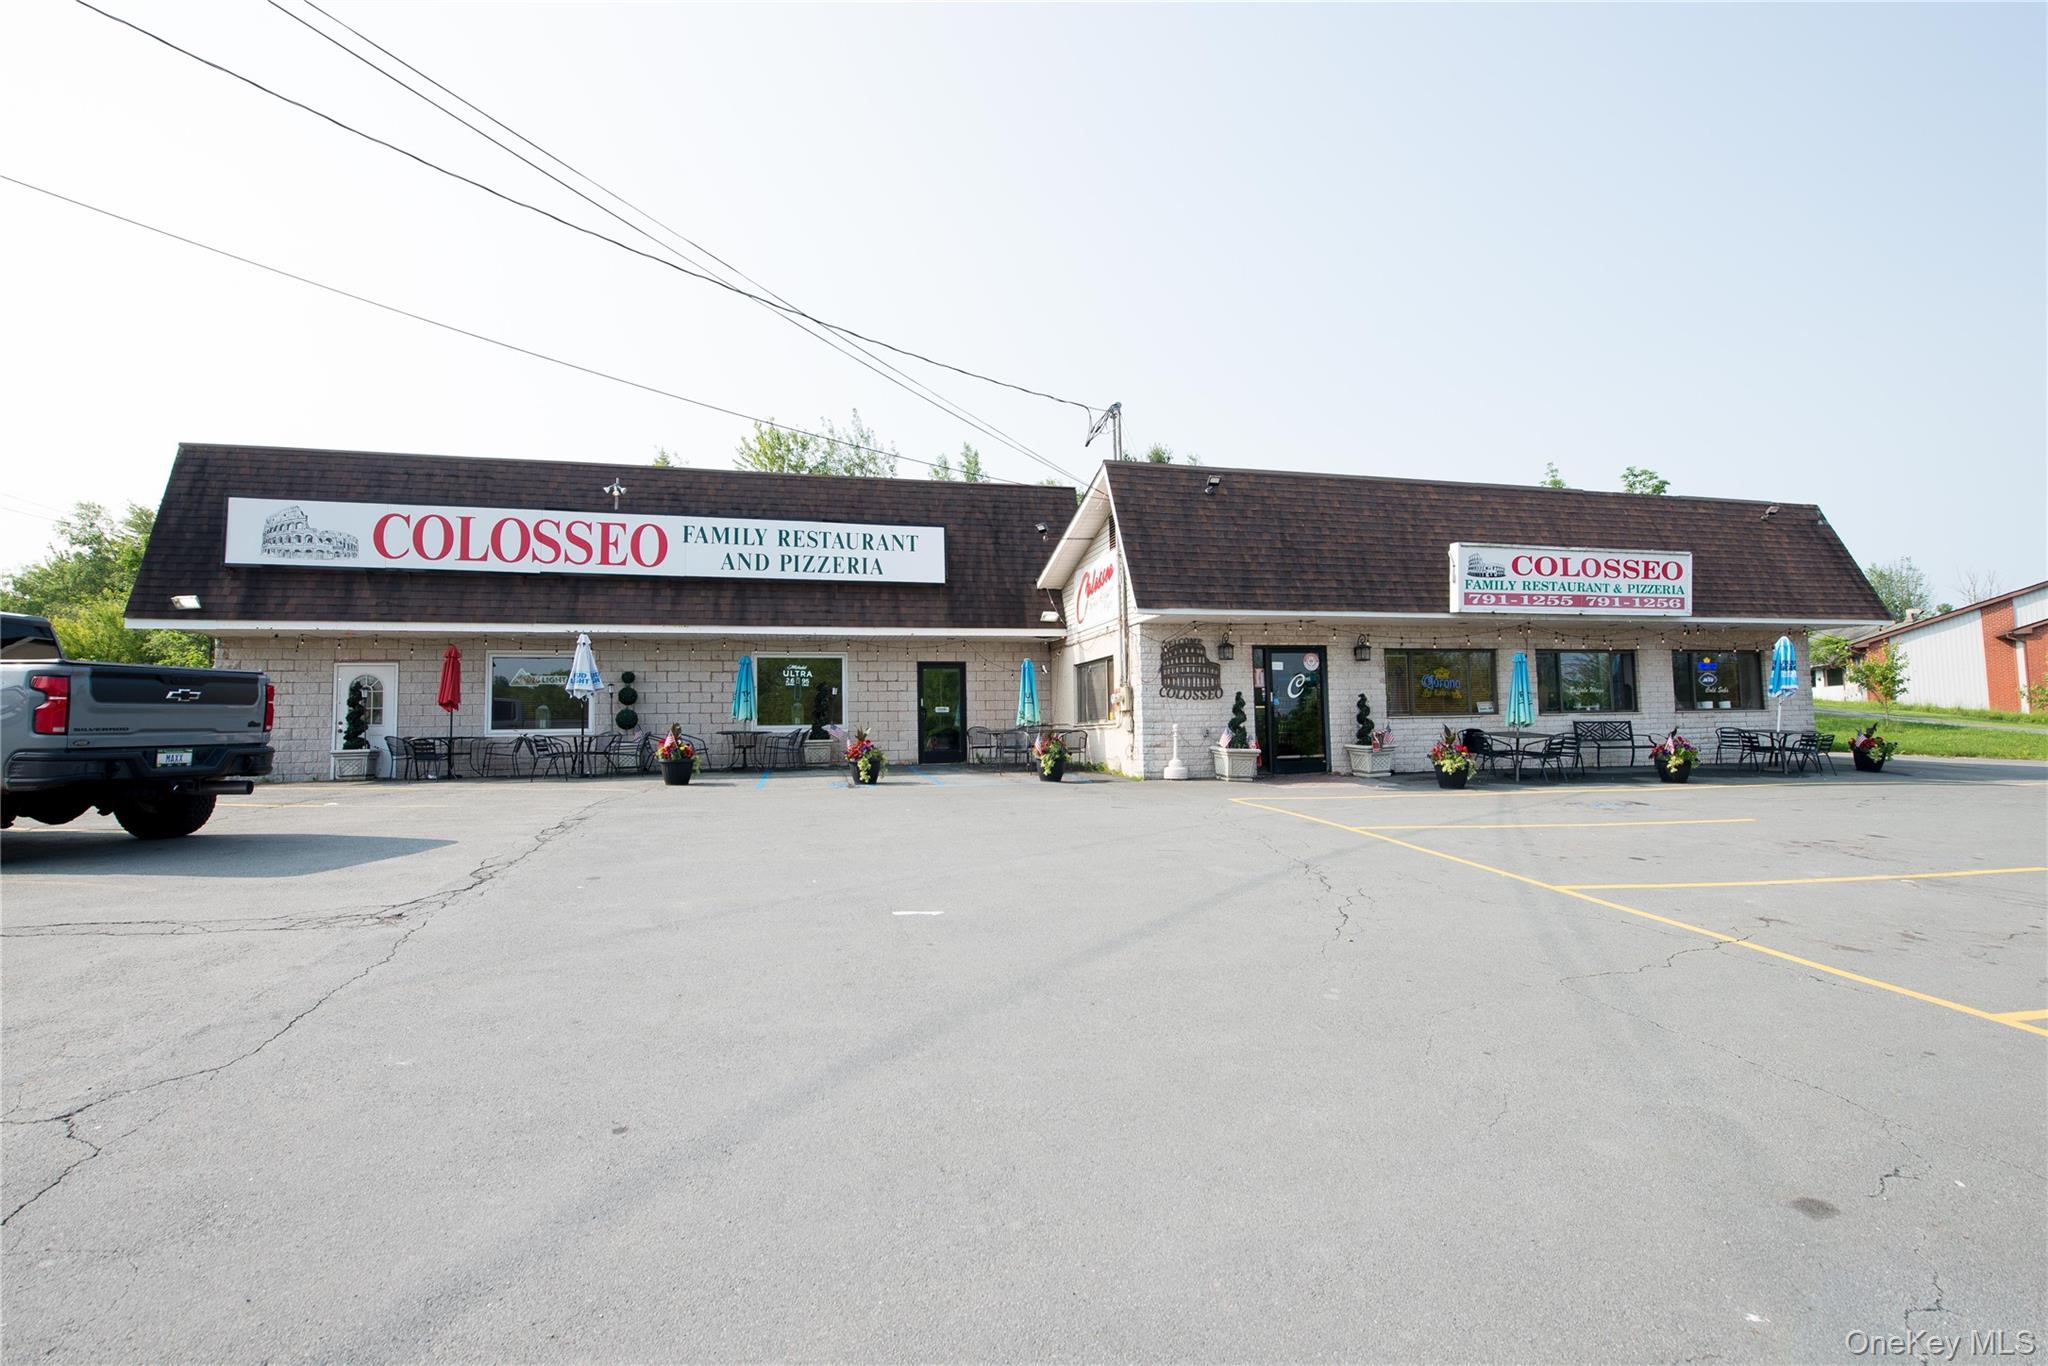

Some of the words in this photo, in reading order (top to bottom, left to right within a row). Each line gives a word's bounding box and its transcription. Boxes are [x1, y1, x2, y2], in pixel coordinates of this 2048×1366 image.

[373, 512, 669, 568] COLOSSEO
[682, 524, 768, 547] FAMILY
[777, 529, 919, 552] RESTAURANT
[721, 552, 770, 572] AND
[780, 554, 884, 576] PIZZERIA
[1511, 555, 1684, 581] COLOSSEO
[1464, 579, 1517, 591] FAMILY
[1522, 580, 1610, 594] RESTAURANT
[1613, 583, 1622, 594] &
[1627, 583, 1685, 595] PIZZERIA
[1468, 593, 1574, 607] 791-1255
[1586, 595, 1682, 609] 791-1256
[541, 675, 568, 684] LIGHT
[782, 670, 813, 678] ULTRA
[1159, 686, 1223, 700] COLOSSEO
